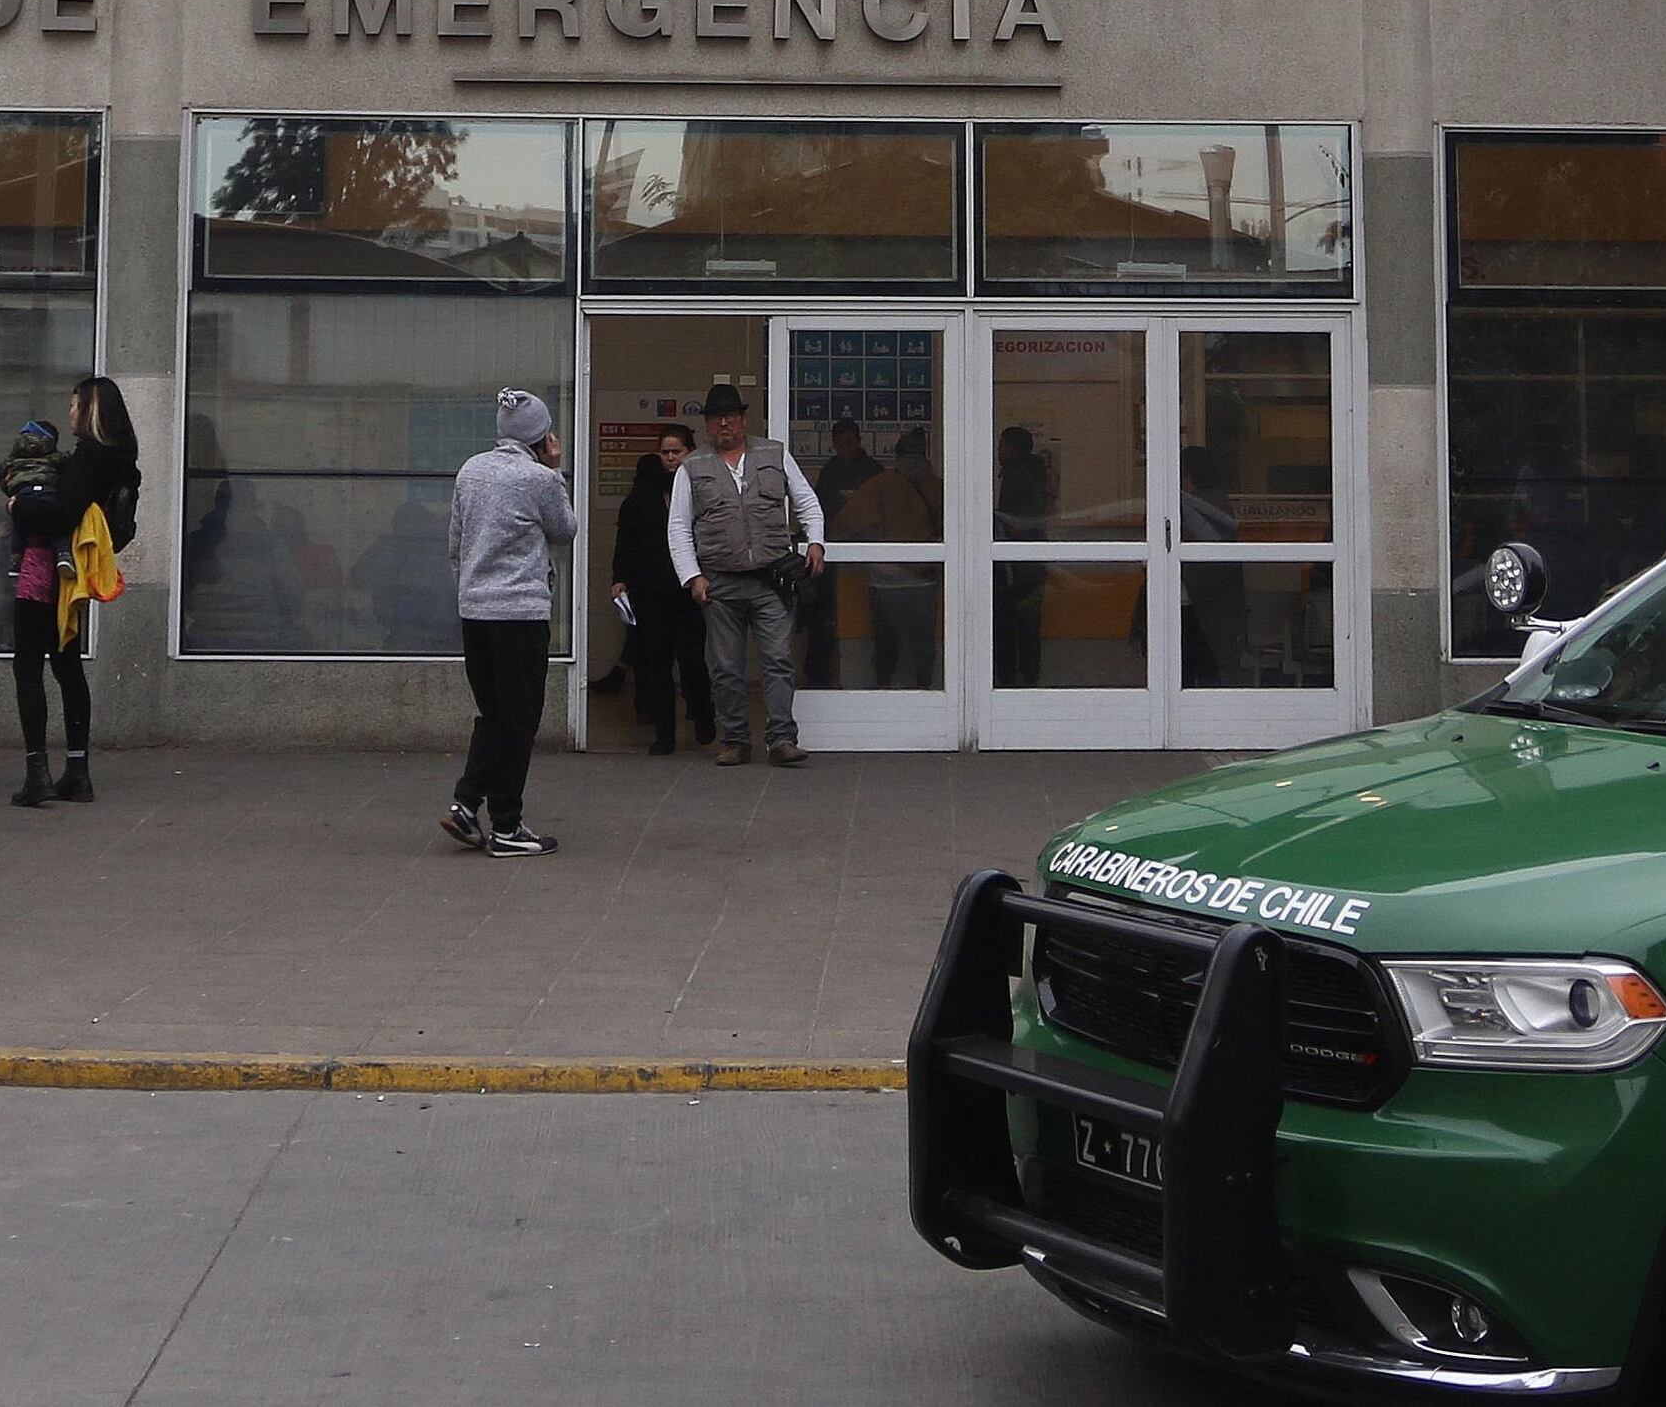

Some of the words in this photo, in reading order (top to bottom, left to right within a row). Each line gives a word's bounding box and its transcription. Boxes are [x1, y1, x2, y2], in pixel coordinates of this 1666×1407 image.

[995, 341, 1106, 353] EGORIZACION
[1048, 841, 1218, 904] CARABINEROS
[1207, 877, 1265, 914] DE
[1259, 886, 1370, 935] CHILE
[1289, 1043, 1365, 1064] DODGE
[1080, 1120, 1096, 1164] Z
[1121, 1132, 1163, 1182] 77
